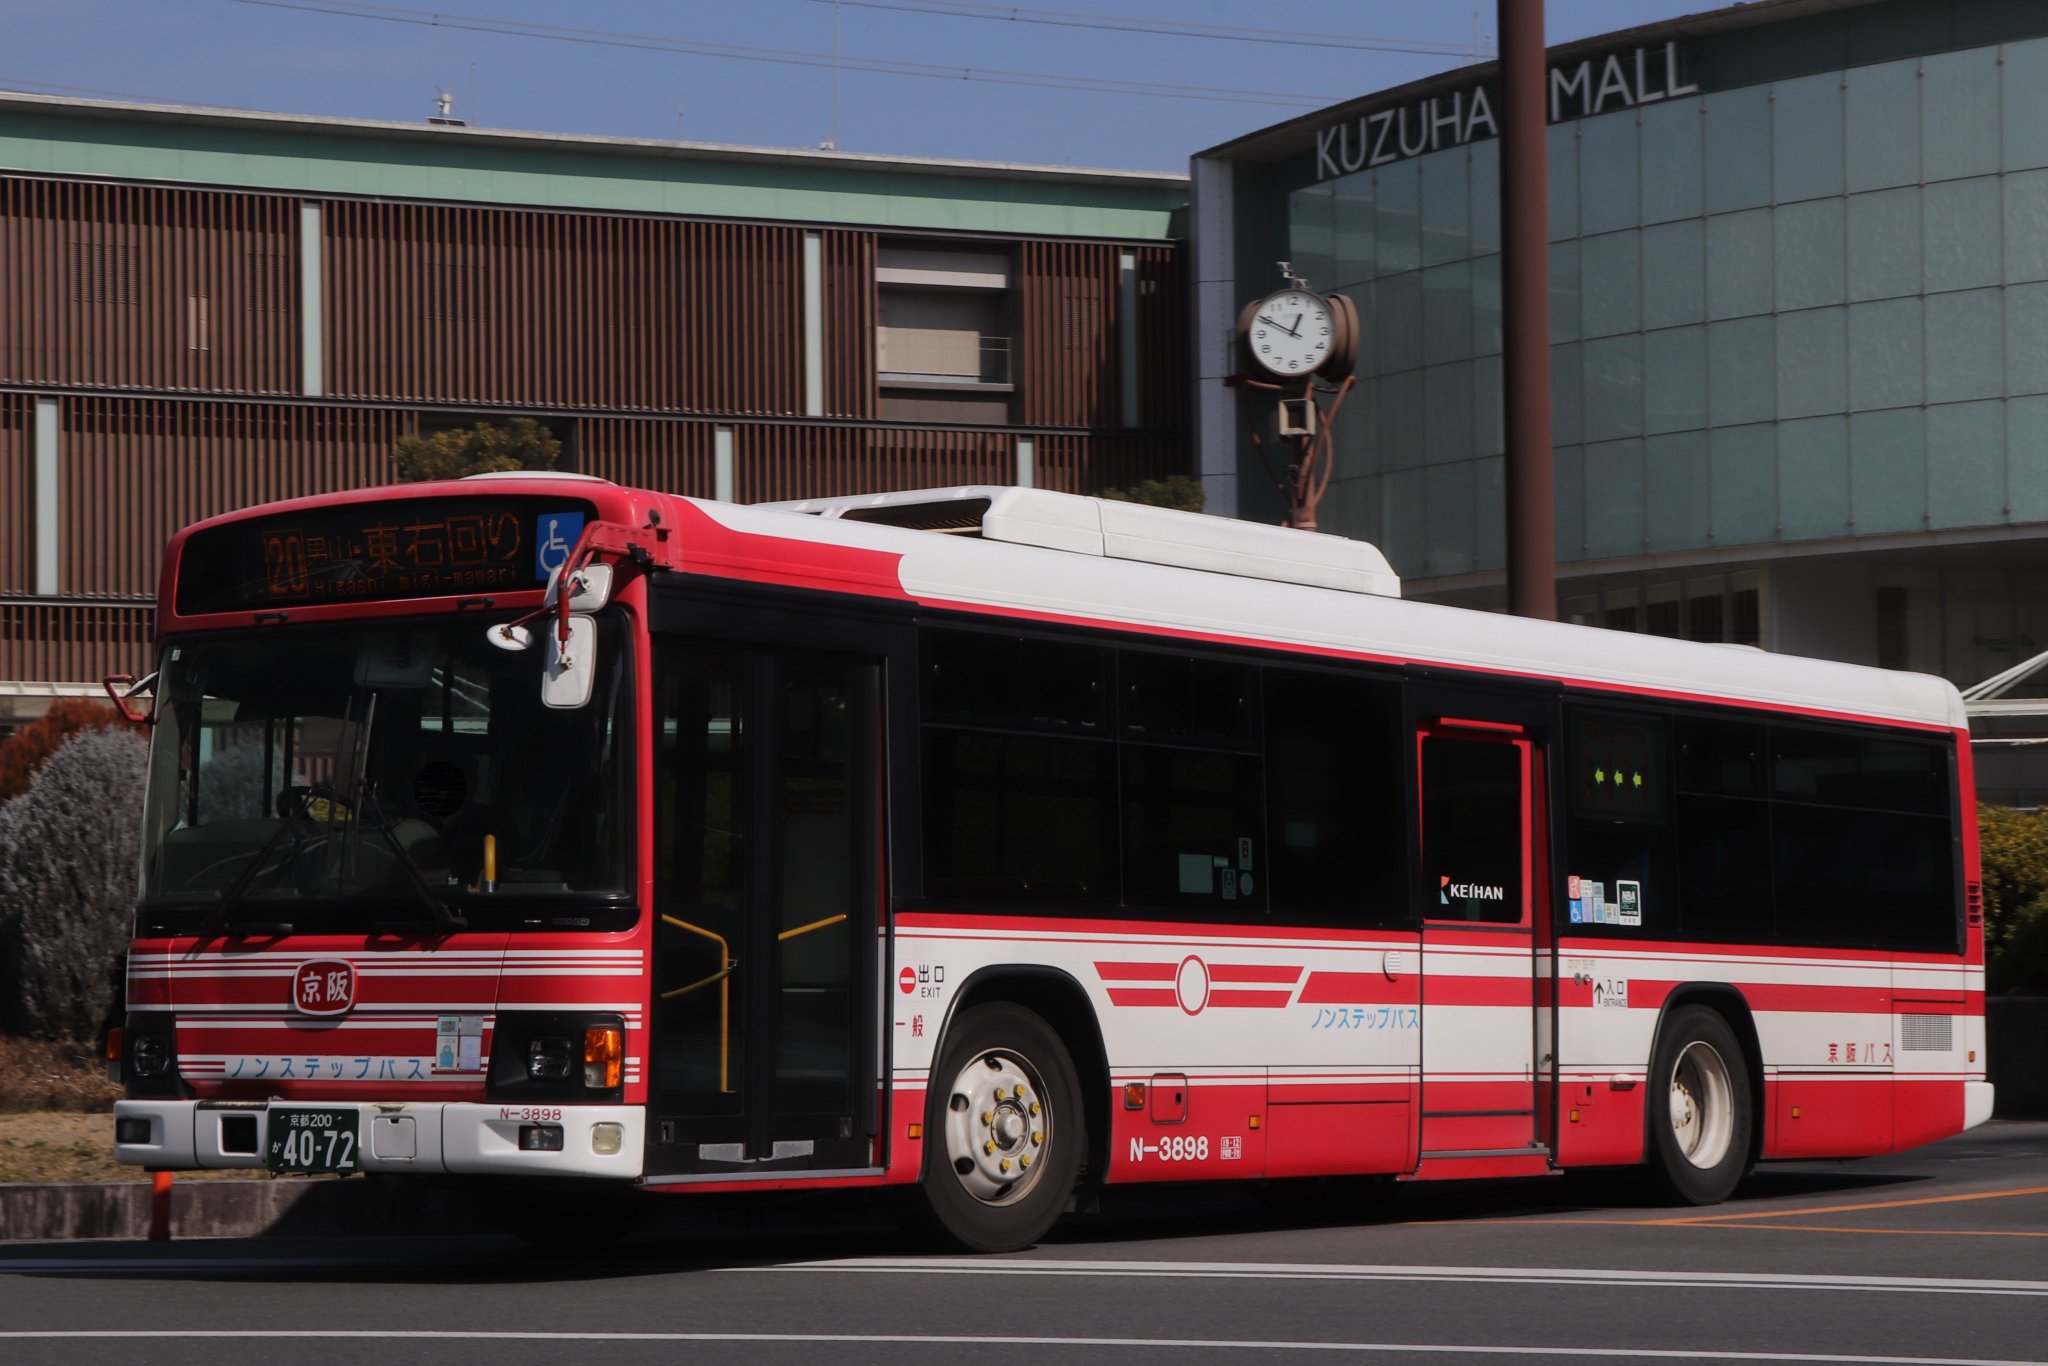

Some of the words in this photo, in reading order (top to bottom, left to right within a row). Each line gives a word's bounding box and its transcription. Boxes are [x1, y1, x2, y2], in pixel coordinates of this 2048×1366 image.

[1316, 86, 1498, 181] KUZUHA
[1551, 41, 1698, 122] MALL
[1315, 311, 1324, 320] 2
[1257, 330, 1266, 339] 9
[1320, 327, 1329, 336] 3
[1262, 344, 1271, 354] 8
[1315, 342, 1325, 350] 4
[1273, 356, 1283, 366] 7
[1288, 360, 1298, 369] 6
[1305, 354, 1315, 364] 5
[267, 536, 305, 593] 20
[1450, 883, 1503, 900] KEIHAN
[918, 964, 944, 983] 出口
[300, 970, 352, 1004] 京阪
[921, 987, 941, 998] EXIT
[1606, 979, 1624, 996] 入口
[895, 1014, 923, 1037] 一般
[1311, 1007, 1419, 1029] ノンステップバス
[1828, 1042, 1894, 1063] 京阪バス
[230, 1057, 427, 1080] ノンステップバス
[500, 1107, 562, 1121] N-3898
[271, 1141, 282, 1154] か
[283, 1130, 354, 1168] 40-72
[1130, 1135, 1209, 1162] N-3898
